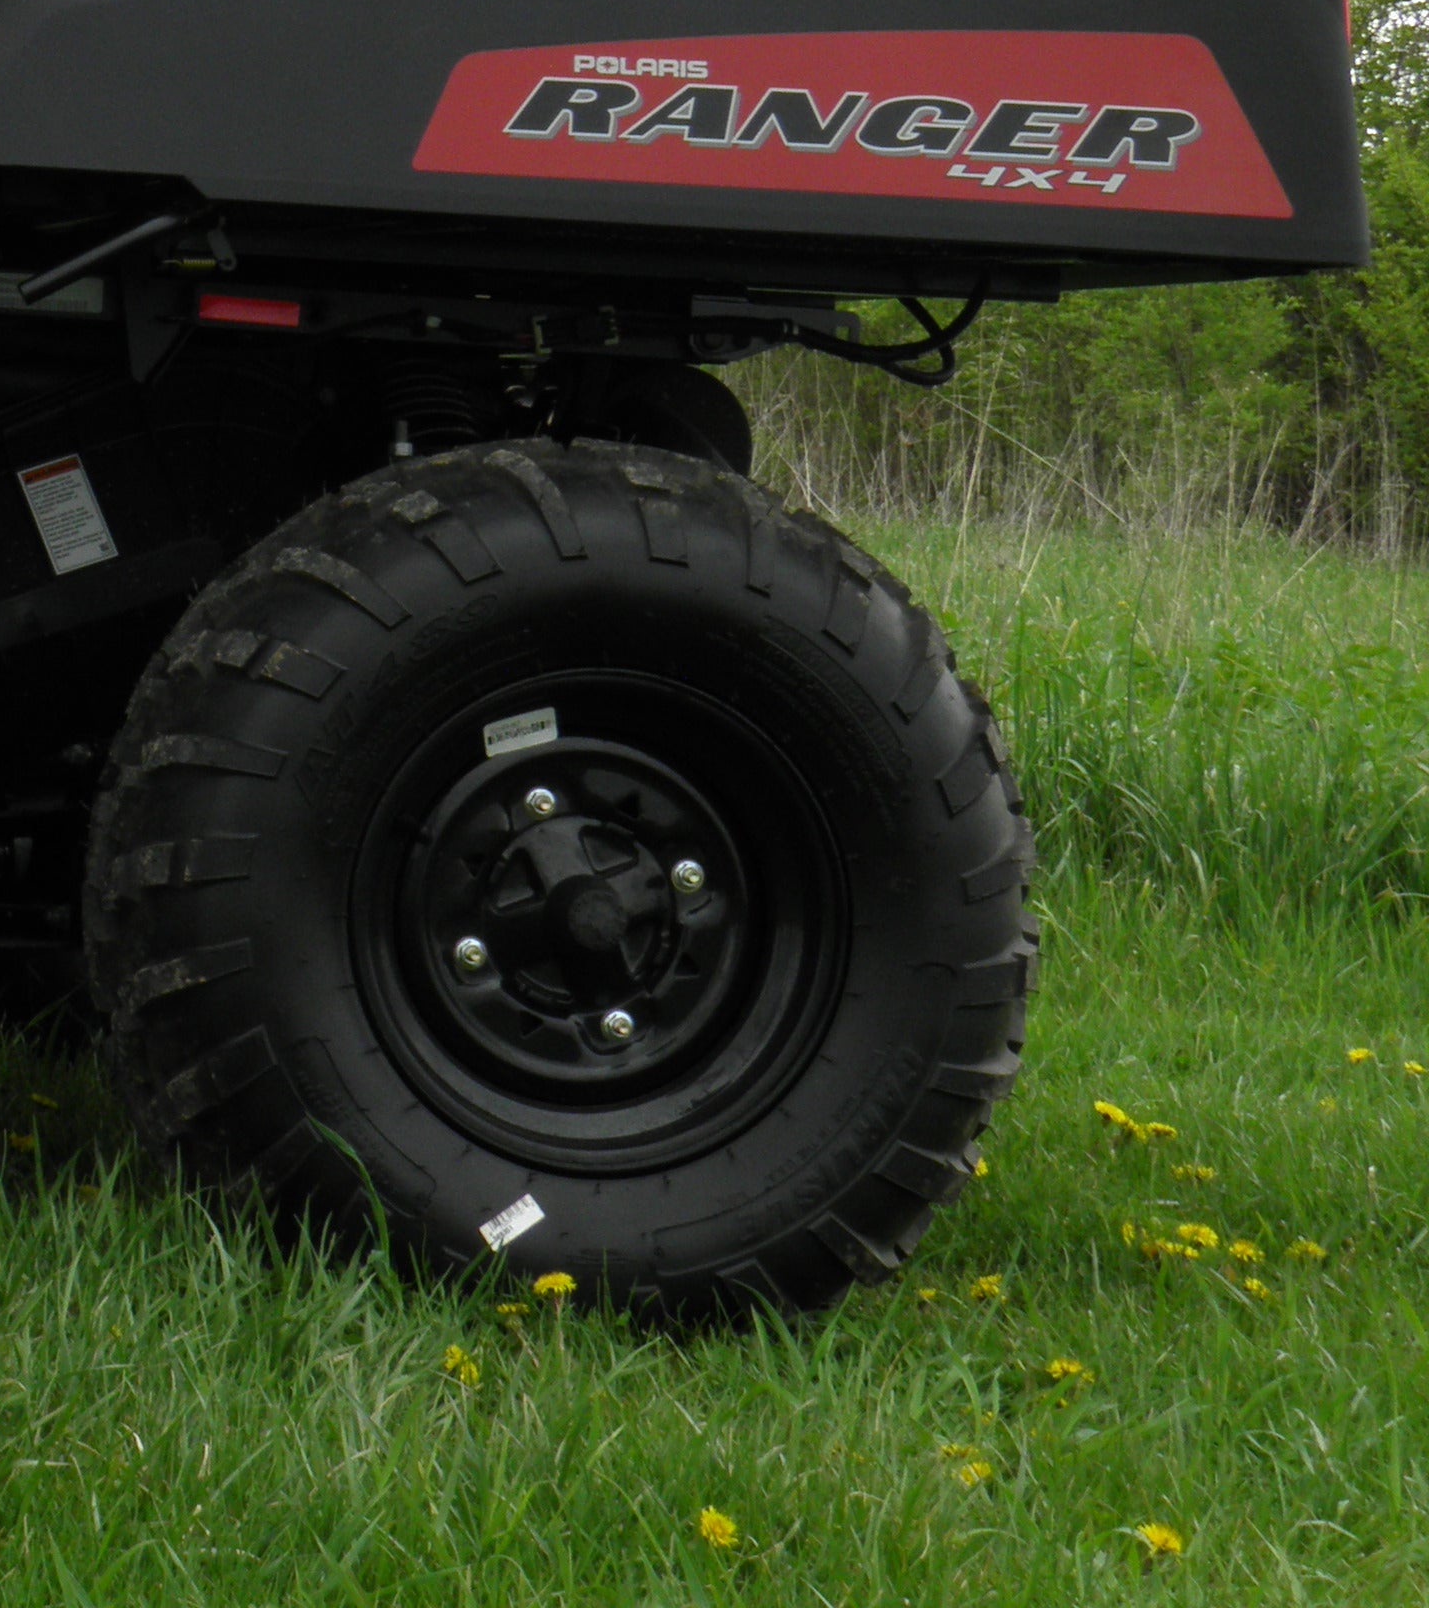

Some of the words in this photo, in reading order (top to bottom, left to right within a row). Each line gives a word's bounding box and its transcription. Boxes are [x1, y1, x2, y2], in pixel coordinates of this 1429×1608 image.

[574, 54, 708, 79] POLARIS
[502, 76, 1202, 171] RANGER
[946, 164, 1129, 194] 4X4
